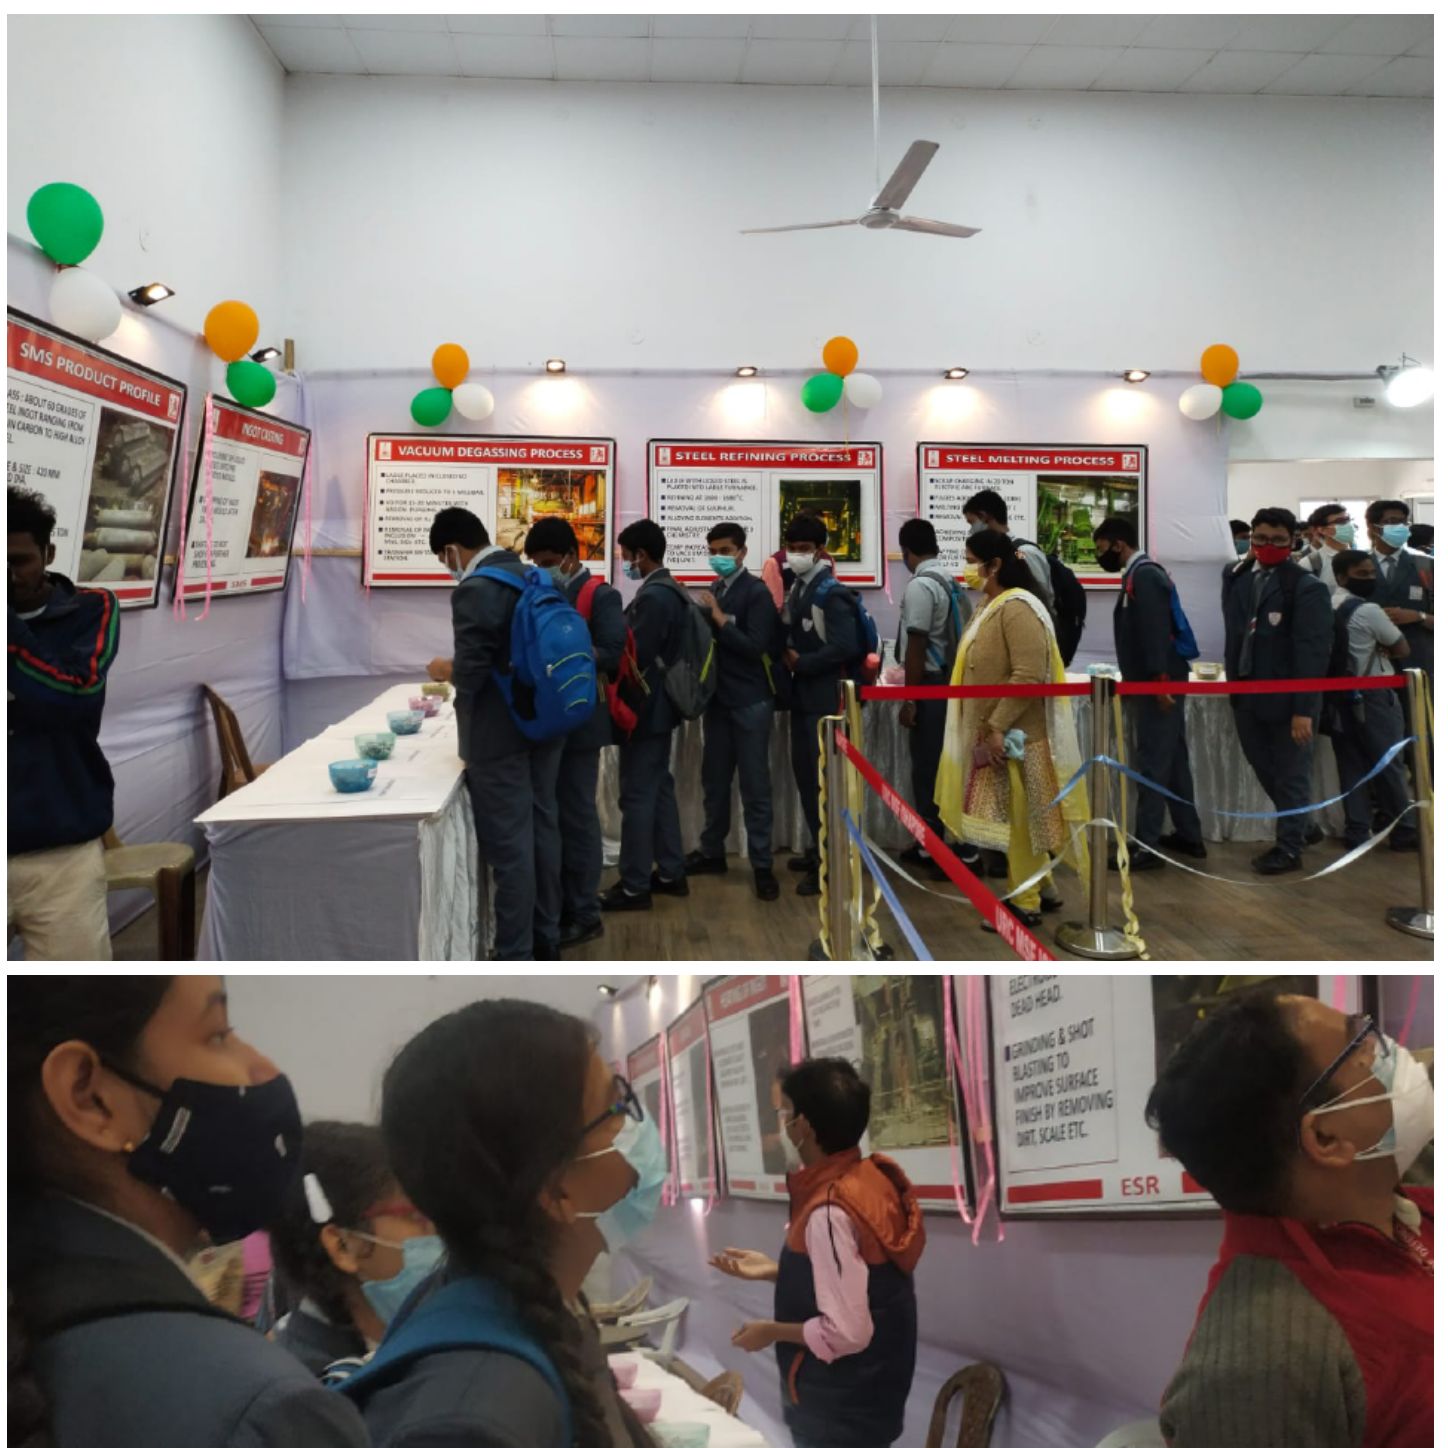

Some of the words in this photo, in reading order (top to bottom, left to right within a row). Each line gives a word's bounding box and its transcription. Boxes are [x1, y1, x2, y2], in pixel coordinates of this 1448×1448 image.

[20, 342, 53, 366] SMS
[56, 356, 117, 390] PRODUCT
[119, 381, 162, 407] PROFILE
[25, 393, 47, 408] ABOUT
[17, 420, 43, 435] CARBON
[398, 445, 454, 457] VACUUM
[458, 446, 527, 459] DEGASSING
[530, 447, 584, 460] PROCESS
[675, 451, 717, 461] STEEL
[720, 452, 786, 462] REFINING
[790, 452, 852, 463] PROCESS
[946, 454, 985, 463] STEEL
[988, 455, 1050, 465] MELTING
[1054, 456, 1115, 466] PROCESS
[1011, 996, 1033, 1018] DEAD
[1012, 1031, 1055, 1060] GRINDING
[1058, 1027, 1066, 1045] &
[1067, 1017, 1094, 1043] SHOT
[1013, 1055, 1054, 1082] BLASTING
[1057, 1051, 1070, 1069] TO
[1014, 1080, 1053, 1103] IMPROVE
[1056, 1068, 1099, 1095] SURFACE
[1015, 1107, 1042, 1126] FINISH
[1045, 1103, 1056, 1121] BY
[1058, 1090, 1114, 1117] REMOVING
[1039, 1124, 1067, 1145] SCALE
[1068, 1120, 1089, 1140] ETC.
[1121, 1176, 1161, 1196] ESR
